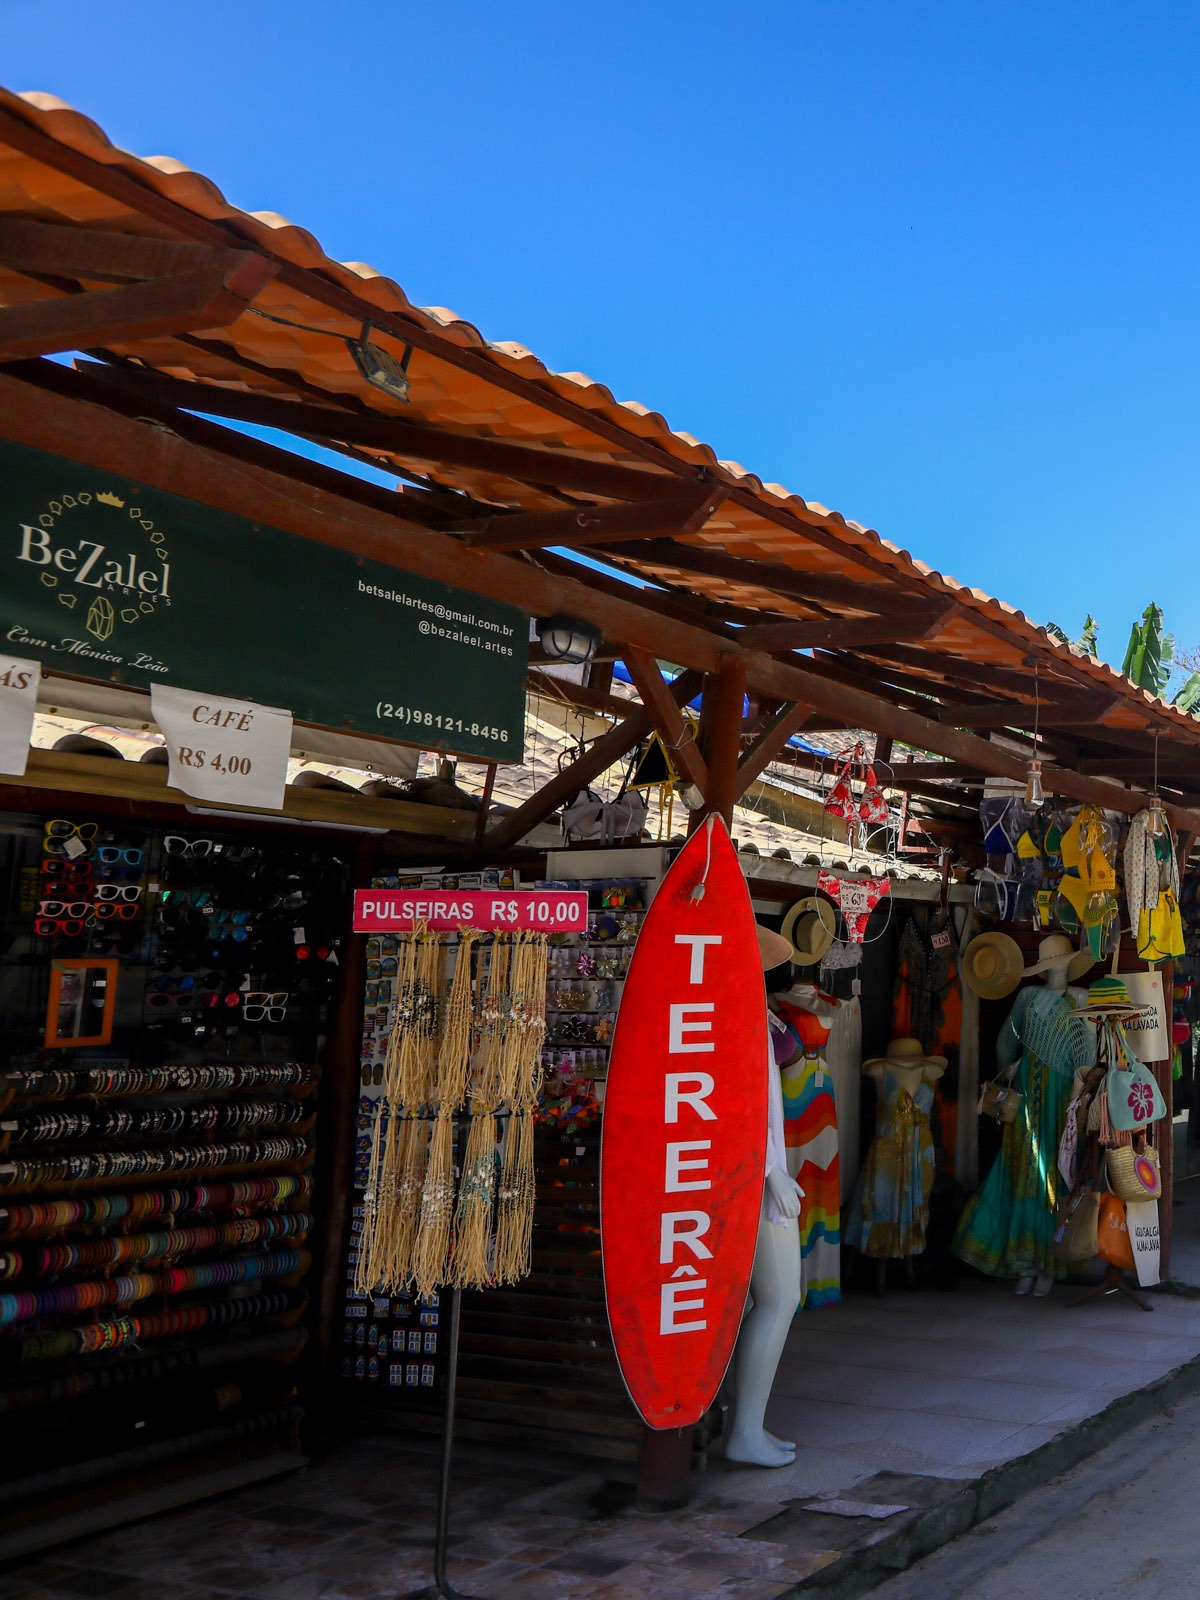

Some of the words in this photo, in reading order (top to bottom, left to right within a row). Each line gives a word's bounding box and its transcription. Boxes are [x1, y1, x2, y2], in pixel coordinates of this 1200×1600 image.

[16, 523, 171, 598] BeZalel
[107, 584, 173, 606] ARTES
[358, 580, 514, 637] betsalelartes@gmail.com.br
[6, 625, 48, 649] Com
[51, 638, 123, 664] Mônica
[128, 653, 170, 674] Leão
[418, 620, 513, 657] @bezaleel.artes
[192, 704, 254, 732] CAFÉ
[376, 701, 509, 743] (24)98121-8456
[178, 746, 206, 768] R$
[210, 755, 251, 776] 4,00
[361, 901, 474, 920] PULSEIRAS
[490, 900, 519, 924] R$
[526, 901, 580, 925] 10,00
[658, 934, 724, 1336] TERERÊ
